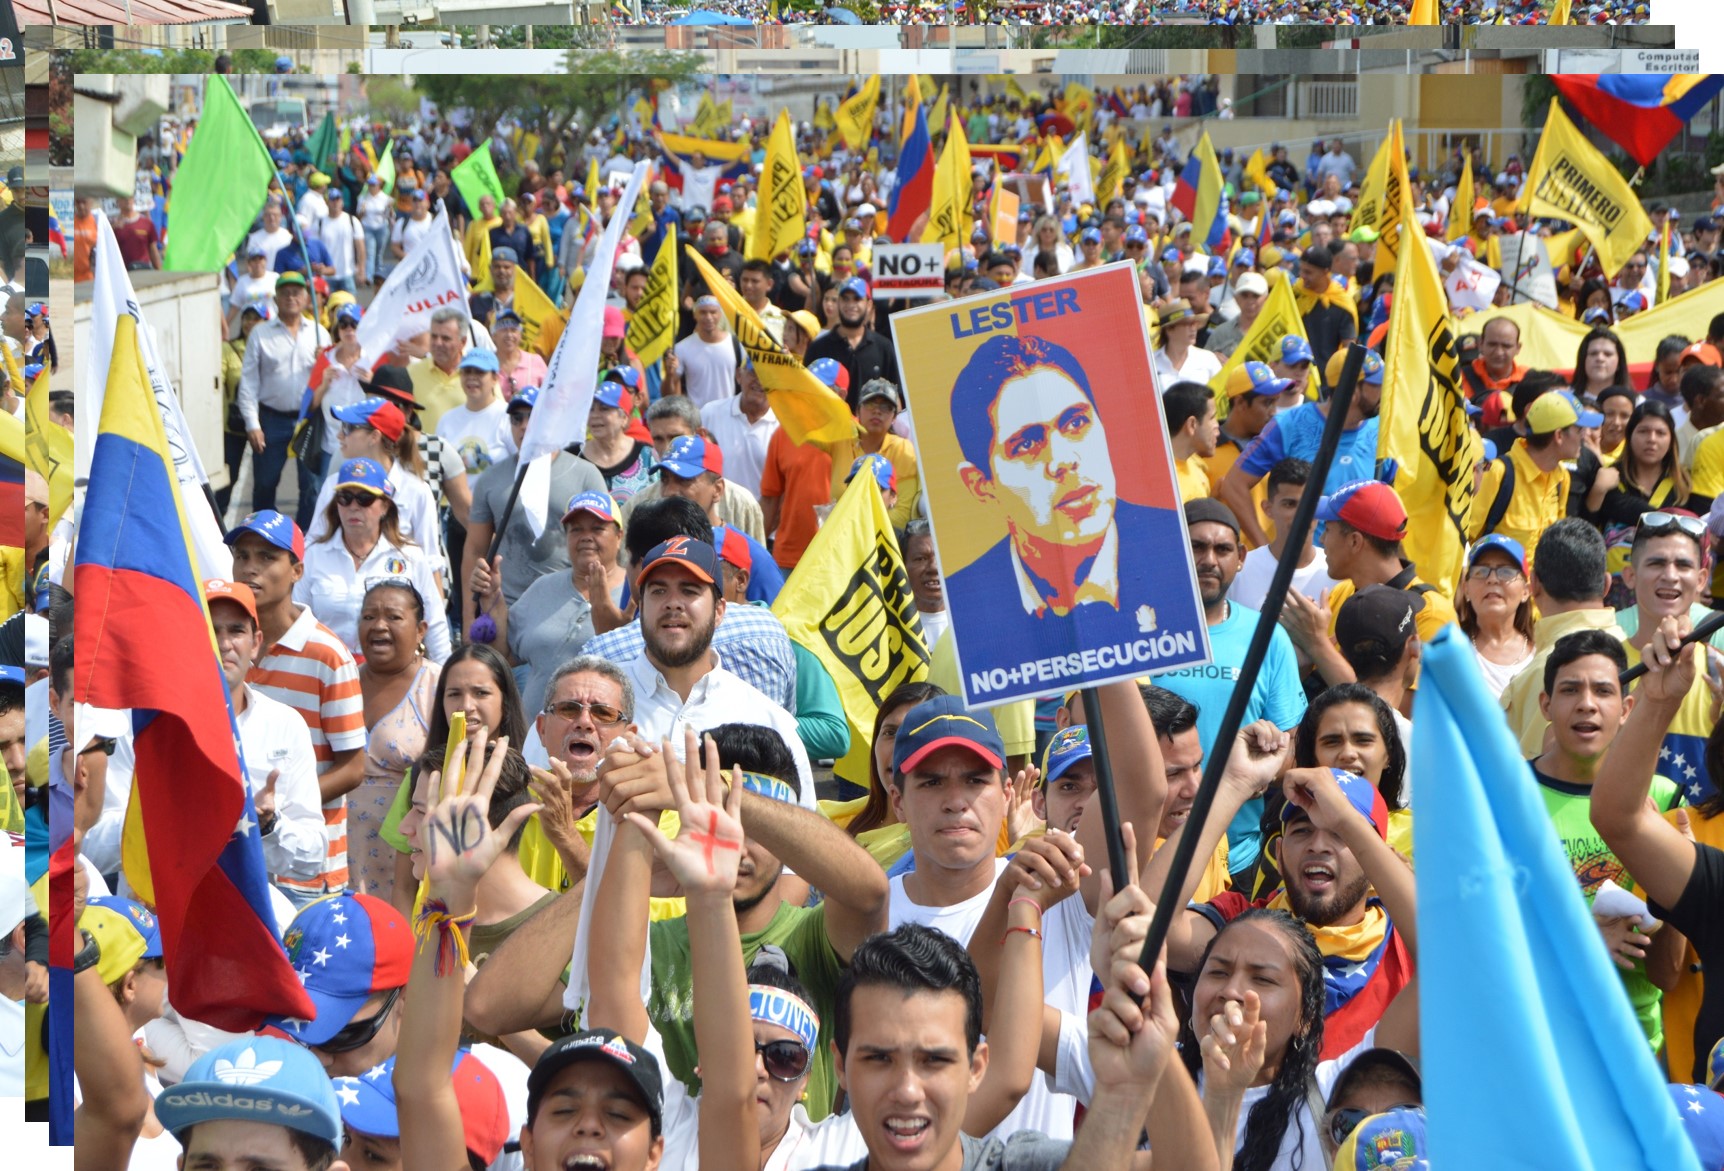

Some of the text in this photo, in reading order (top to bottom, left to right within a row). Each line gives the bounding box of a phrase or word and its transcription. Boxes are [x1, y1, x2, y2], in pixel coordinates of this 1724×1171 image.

[1554, 157, 1620, 223] PRIMERO
[879, 254, 939, 276] NO+
[950, 288, 1081, 339] LESTER
[662, 535, 690, 556] Z
[970, 630, 1196, 695] NO+PERSECUCIÓN
[429, 802, 485, 865] NO
[165, 1092, 273, 1111] adidas
